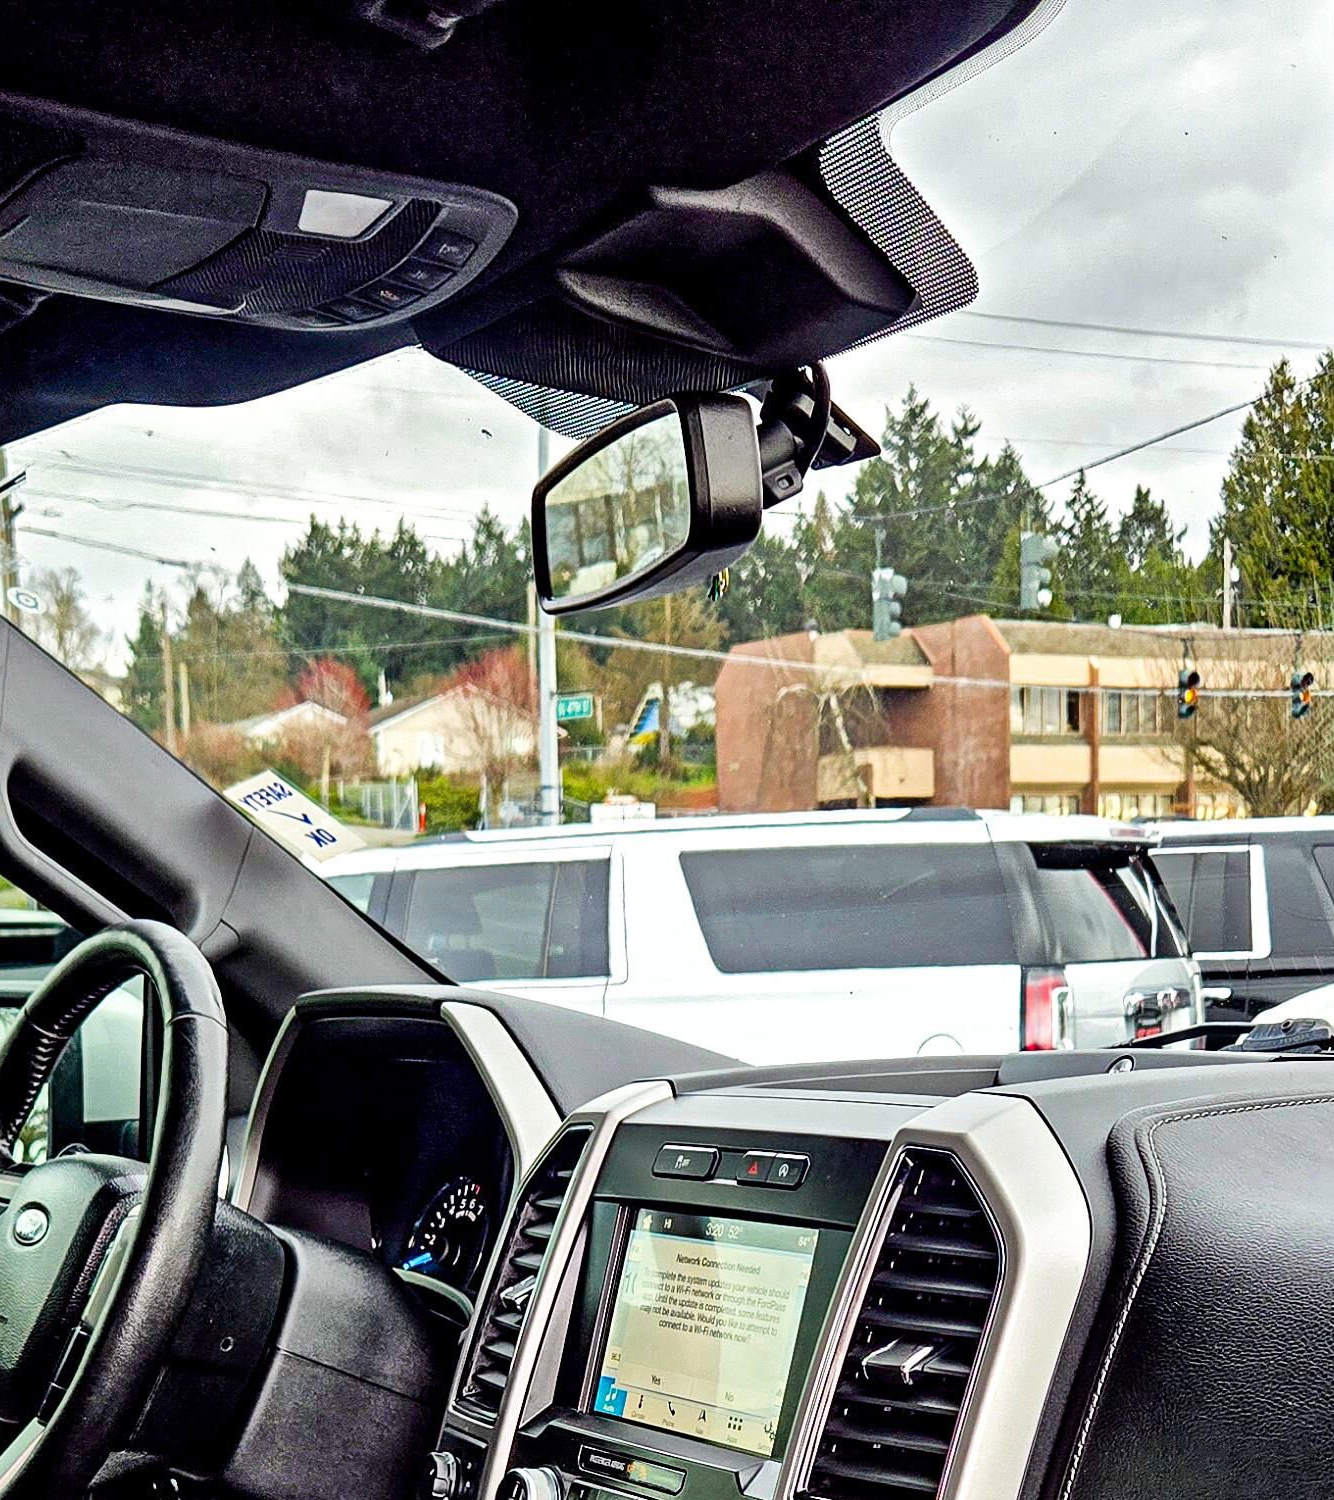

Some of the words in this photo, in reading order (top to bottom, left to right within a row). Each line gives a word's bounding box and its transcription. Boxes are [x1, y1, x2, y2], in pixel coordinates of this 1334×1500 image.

[429, 1234, 436, 1245] 2
[438, 1218, 446, 1229] 3
[449, 1205, 455, 1216] 4
[459, 1199, 467, 1209] 5
[469, 1199, 477, 1209] 6
[477, 1205, 484, 1216] 7
[706, 1223, 725, 1238] 3:20
[676, 1253, 700, 1265] Network
[701, 1257, 736, 1271] Connection
[736, 1263, 761, 1275] Needed
[677, 1272, 686, 1282] the
[687, 1276, 708, 1285] system
[677, 1285, 690, 1295] Wi-Fi
[692, 1289, 713, 1299] network
[655, 1292, 668, 1303] Until
[669, 1296, 678, 1305] the
[679, 1299, 698, 1309] update
[640, 1305, 652, 1315] may
[652, 1306, 661, 1314] not
[697, 1313, 715, 1324] Would
[715, 1318, 727, 1327] you
[658, 1320, 682, 1330] connect
[694, 1325, 710, 1336] Wi-Fi
[709, 1329, 732, 1340] network
[652, 1375, 661, 1386] Yes
[724, 1391, 734, 1402] No
